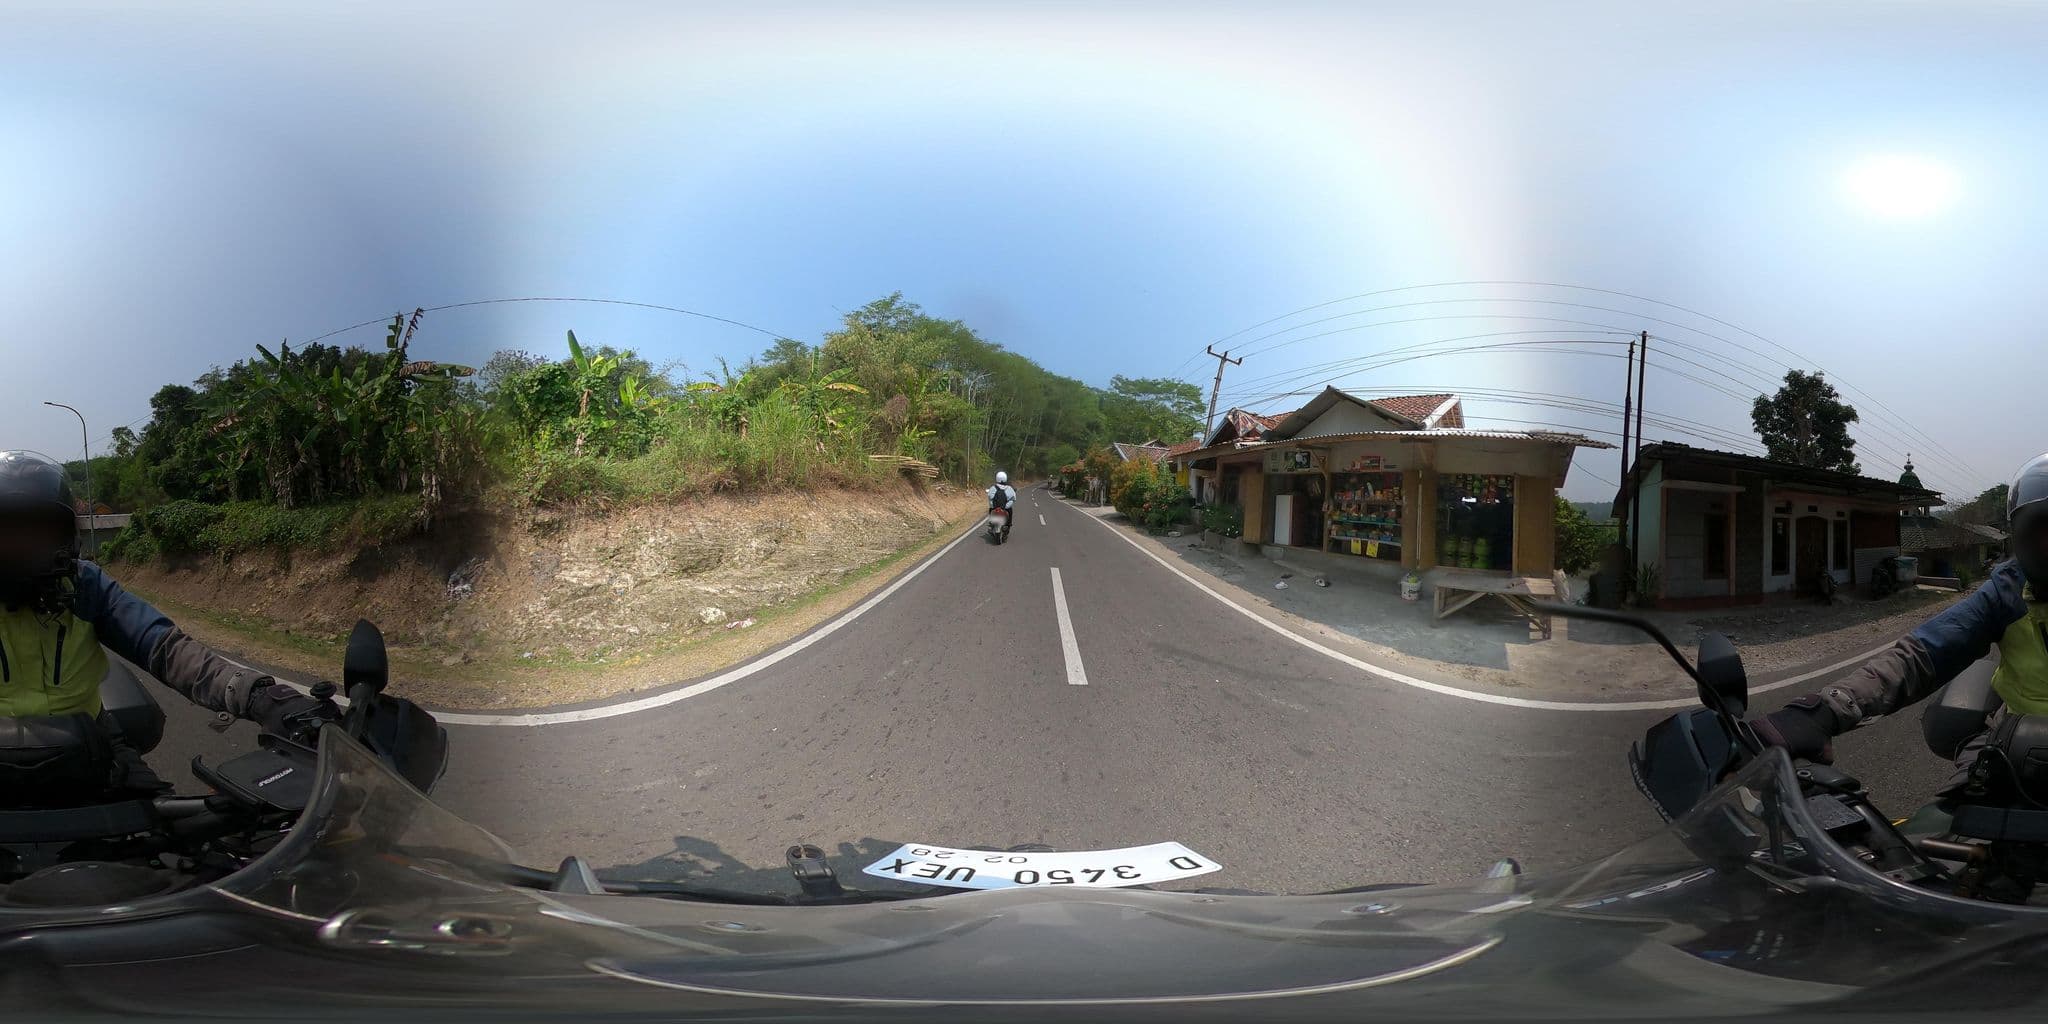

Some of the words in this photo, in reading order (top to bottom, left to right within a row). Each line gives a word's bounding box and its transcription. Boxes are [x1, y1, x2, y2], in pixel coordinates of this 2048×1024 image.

[879, 858, 977, 882] UEX
[1169, 856, 1203, 870] D
[1014, 865, 1142, 885] 3450
